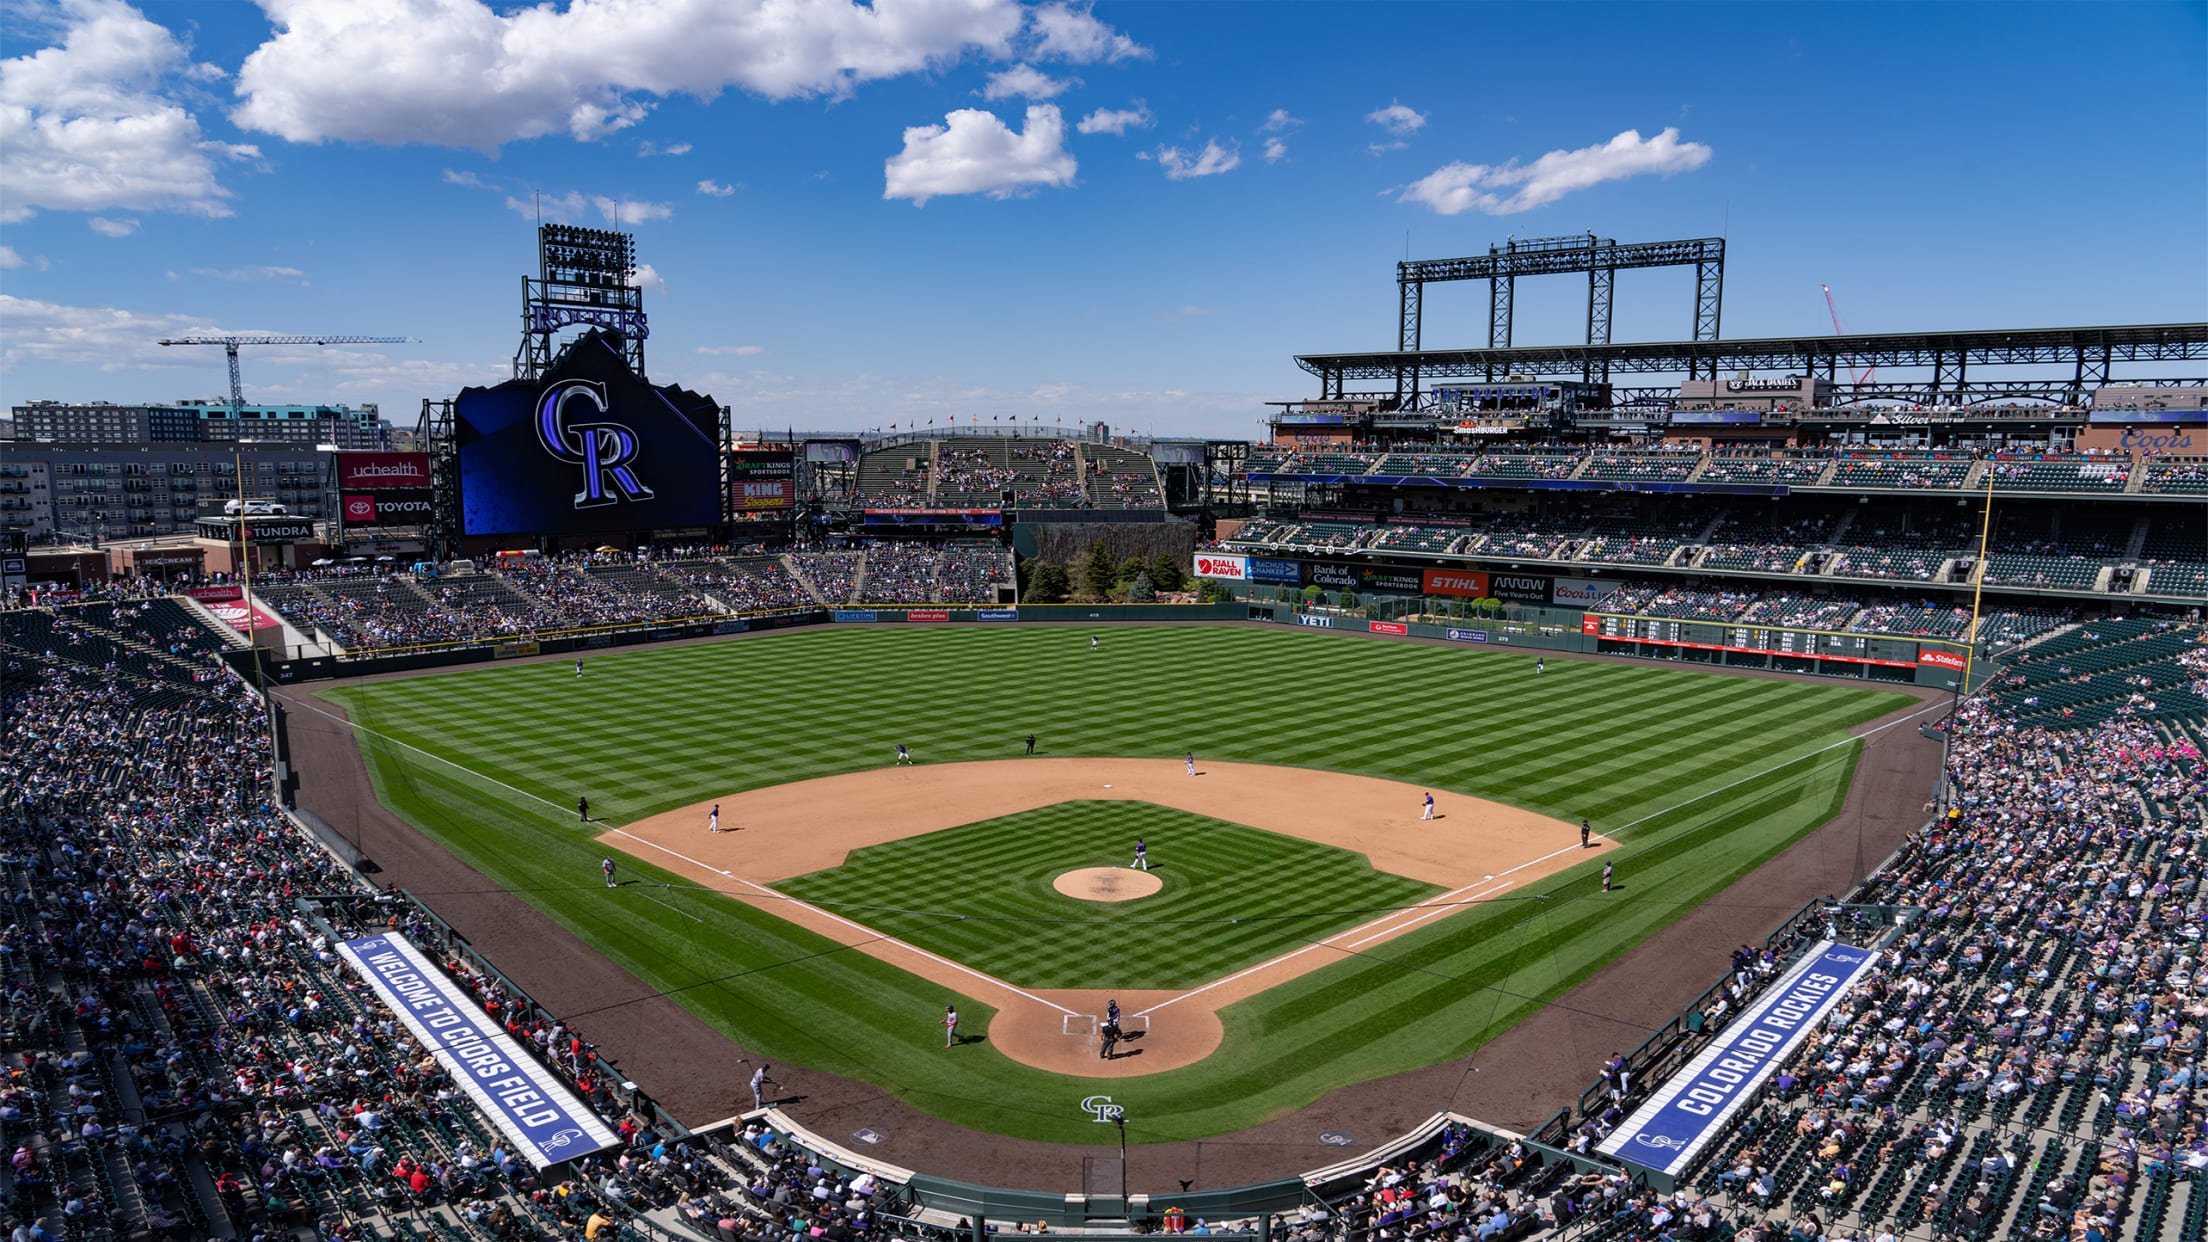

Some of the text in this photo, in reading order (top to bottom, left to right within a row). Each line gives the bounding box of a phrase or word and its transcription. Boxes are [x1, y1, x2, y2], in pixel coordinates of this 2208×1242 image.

[531, 306, 650, 339] ROCKIES
[1745, 376, 1765, 387] JACK
[1432, 387, 1551, 401] THE ROOFTOP
[1891, 414, 1929, 424] Silver
[1295, 431, 1331, 443] Coors
[2120, 429, 2192, 448] Coors
[353, 461, 418, 476] uchealth
[744, 483, 783, 496] KING
[375, 501, 432, 512] TOYOTA
[253, 526, 310, 537] TUNDRA
[1255, 560, 1285, 569] BACHUS
[1313, 565, 1350, 576] Bank of
[1247, 567, 1285, 575] SCHANKER
[1313, 573, 1357, 586] Colorado
[1362, 573, 1419, 584] DRAFTKINGS
[1431, 577, 1480, 590] STIHL
[1494, 577, 1545, 590] ARROW
[1375, 581, 1418, 590] SPORTSBOOK
[194, 588, 232, 598] uchealth
[1509, 591, 1529, 599] Years
[1530, 592, 1544, 600] Out
[1555, 586, 1591, 599] Coors
[1300, 615, 1331, 627] YETI
[368, 951, 560, 1128] WELCOME TO COORS FIELD
[1676, 972, 1840, 1117] COLORADO ROCKIES
